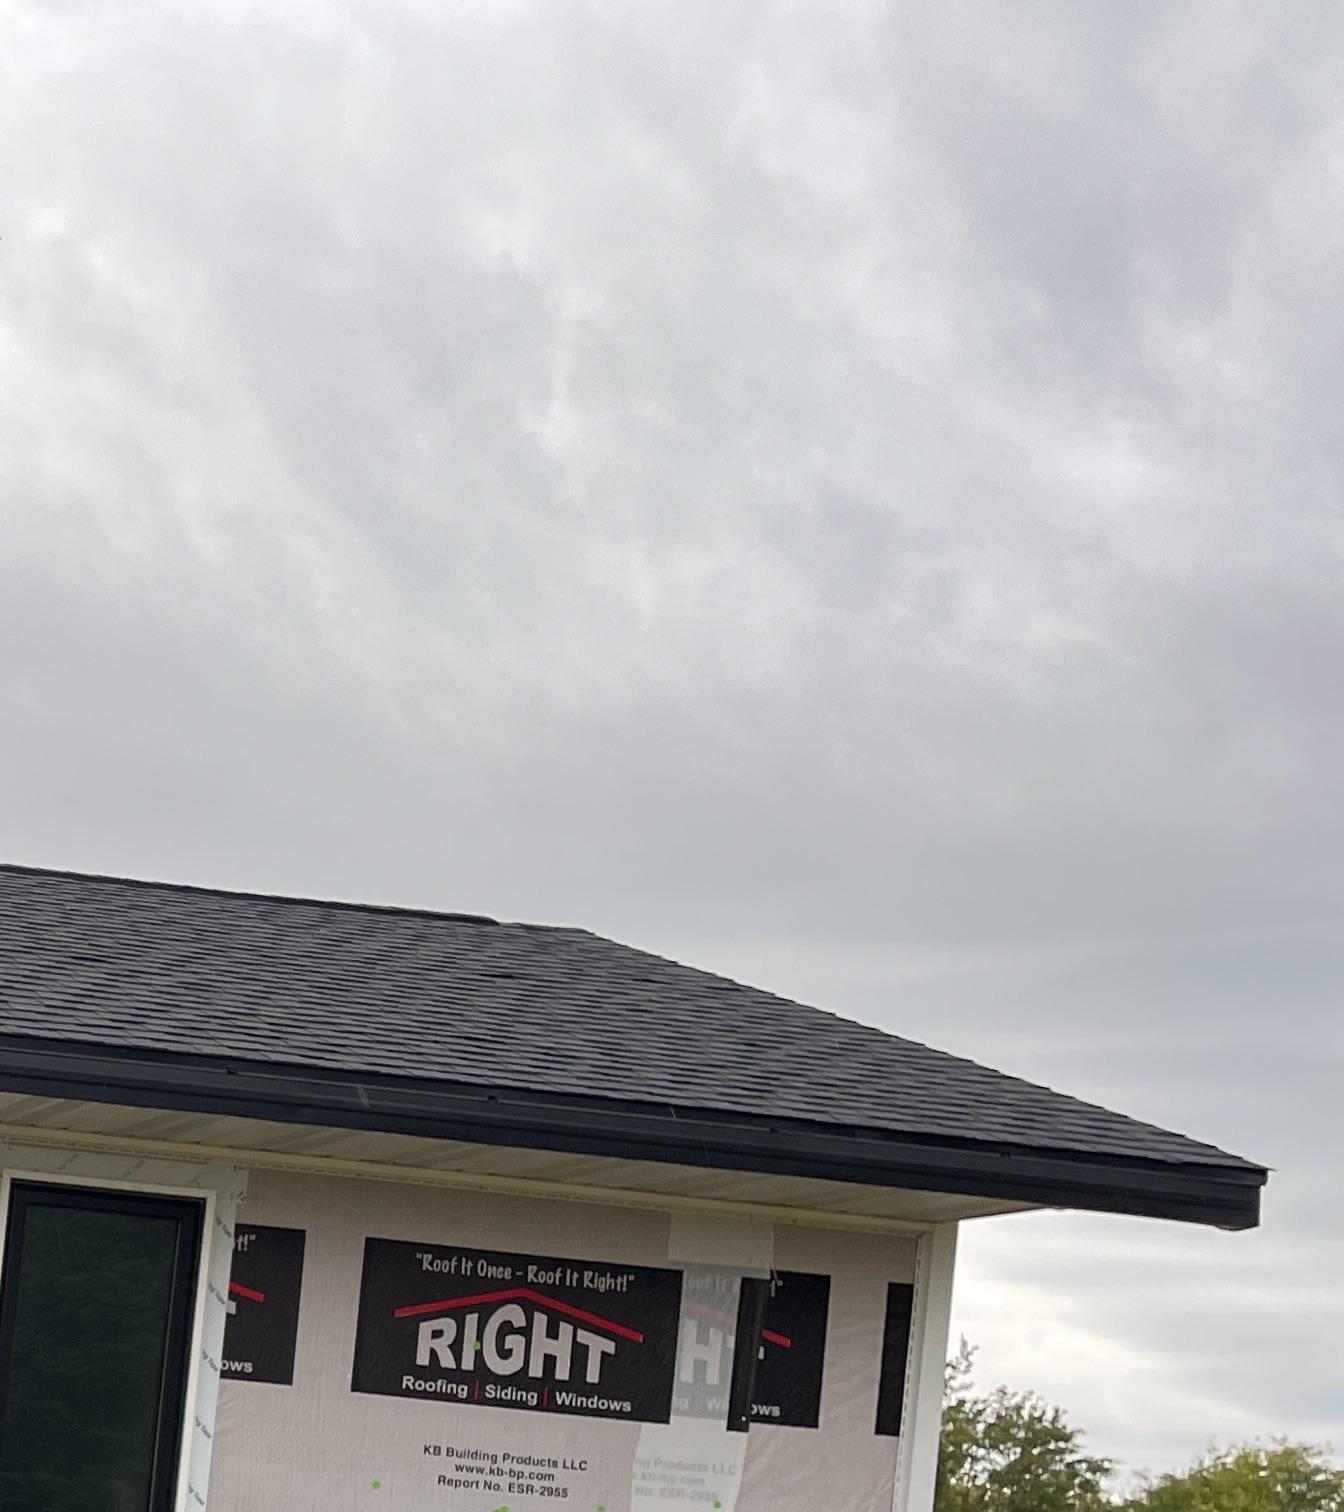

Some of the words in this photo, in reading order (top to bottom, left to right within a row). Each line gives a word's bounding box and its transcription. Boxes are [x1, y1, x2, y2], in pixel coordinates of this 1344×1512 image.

[416, 1252, 458, 1273] "Roof
[461, 1257, 472, 1274] It
[477, 1259, 512, 1279] Once
[527, 1264, 562, 1286] Roof
[566, 1268, 580, 1287] It
[583, 1270, 635, 1293] Right!"
[415, 1302, 616, 1385] RIGHT
[401, 1375, 469, 1398] Roofing
[484, 1384, 539, 1405] Siding
[555, 1391, 633, 1412] Windows
[423, 1444, 442, 1456] KB
[445, 1446, 498, 1465] Building
[502, 1452, 559, 1469] Products
[562, 1459, 588, 1471] LLC
[454, 1462, 555, 1482] www.kb-bp.com
[437, 1475, 479, 1491] Report
[483, 1479, 503, 1492] No.
[508, 1482, 569, 1498] ESR-2955
